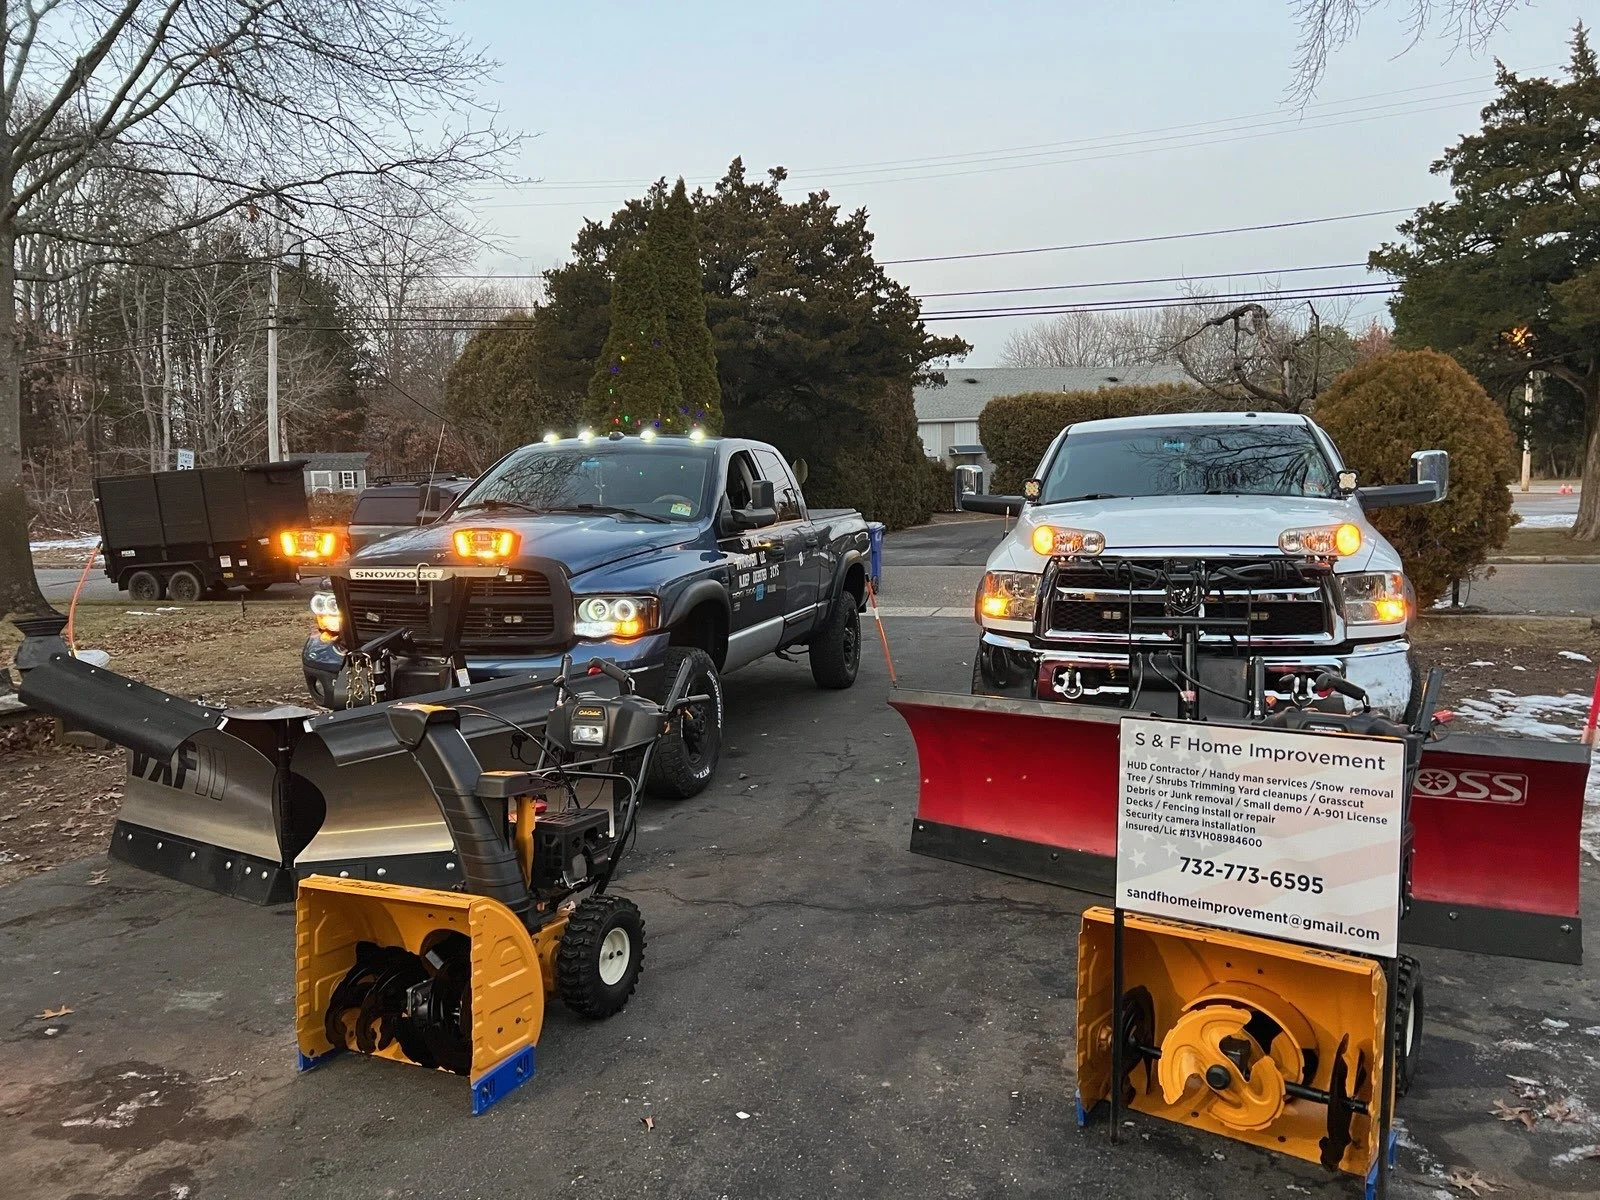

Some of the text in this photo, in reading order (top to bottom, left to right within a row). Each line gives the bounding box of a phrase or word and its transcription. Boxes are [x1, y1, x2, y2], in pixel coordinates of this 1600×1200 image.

[1135, 732, 1386, 770] S & F Home Improvement
[1127, 760, 1147, 771] HUD
[1149, 763, 1199, 776] Contractor
[1202, 768, 1208, 778] /
[1209, 769, 1241, 782] Handy
[1243, 775, 1264, 784] man
[1266, 776, 1308, 789] services
[1349, 786, 1394, 798] removal
[1127, 773, 1364, 808] Tree / Shrubs Trimming Yard cleanups / Grasscut
[1413, 768, 1523, 802] OSS
[1125, 809, 1256, 834] Security camera installation
[1126, 785, 1388, 825] Debris or Junk removal / Small demo / A-901 License
[1126, 797, 1276, 824] Decks / Fencing install or repair
[1125, 821, 1263, 848] Insured/Lic #13VH08984600
[1179, 856, 1324, 894] 732-773-6595
[1127, 887, 1380, 941] sandfhomeimprovement@gmail.com
